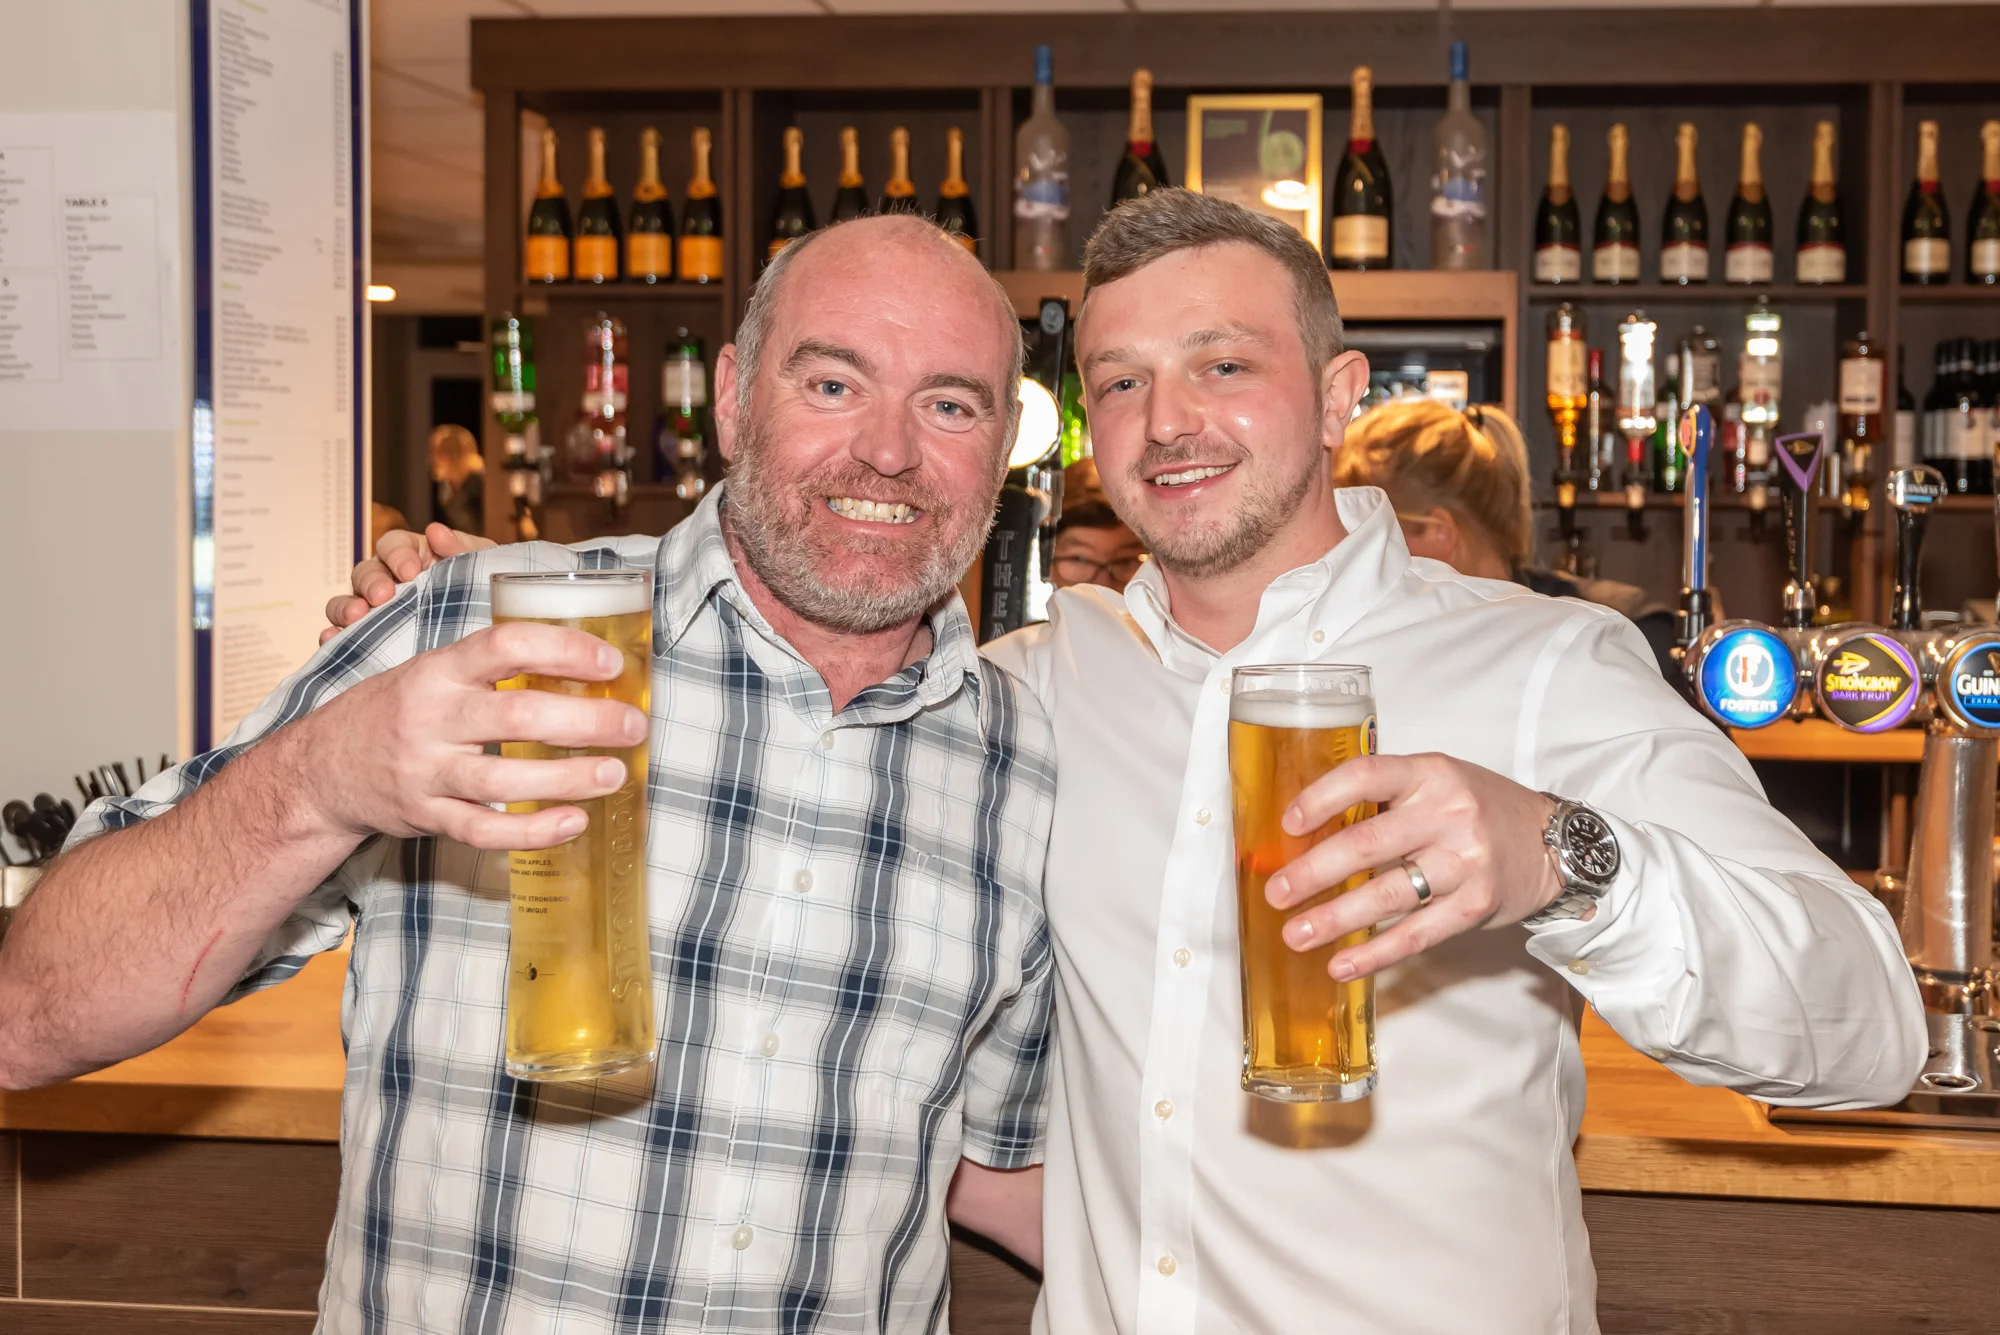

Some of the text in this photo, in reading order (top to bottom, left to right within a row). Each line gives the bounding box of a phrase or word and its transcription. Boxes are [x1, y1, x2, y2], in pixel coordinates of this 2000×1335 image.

[66, 198, 97, 207] TABLE
[1825, 673, 1899, 692] STRONGBOW
[1957, 673, 2000, 696] GUIN
[1832, 690, 1891, 702] DARK FRUIT
[1971, 697, 1998, 705] EXTRA
